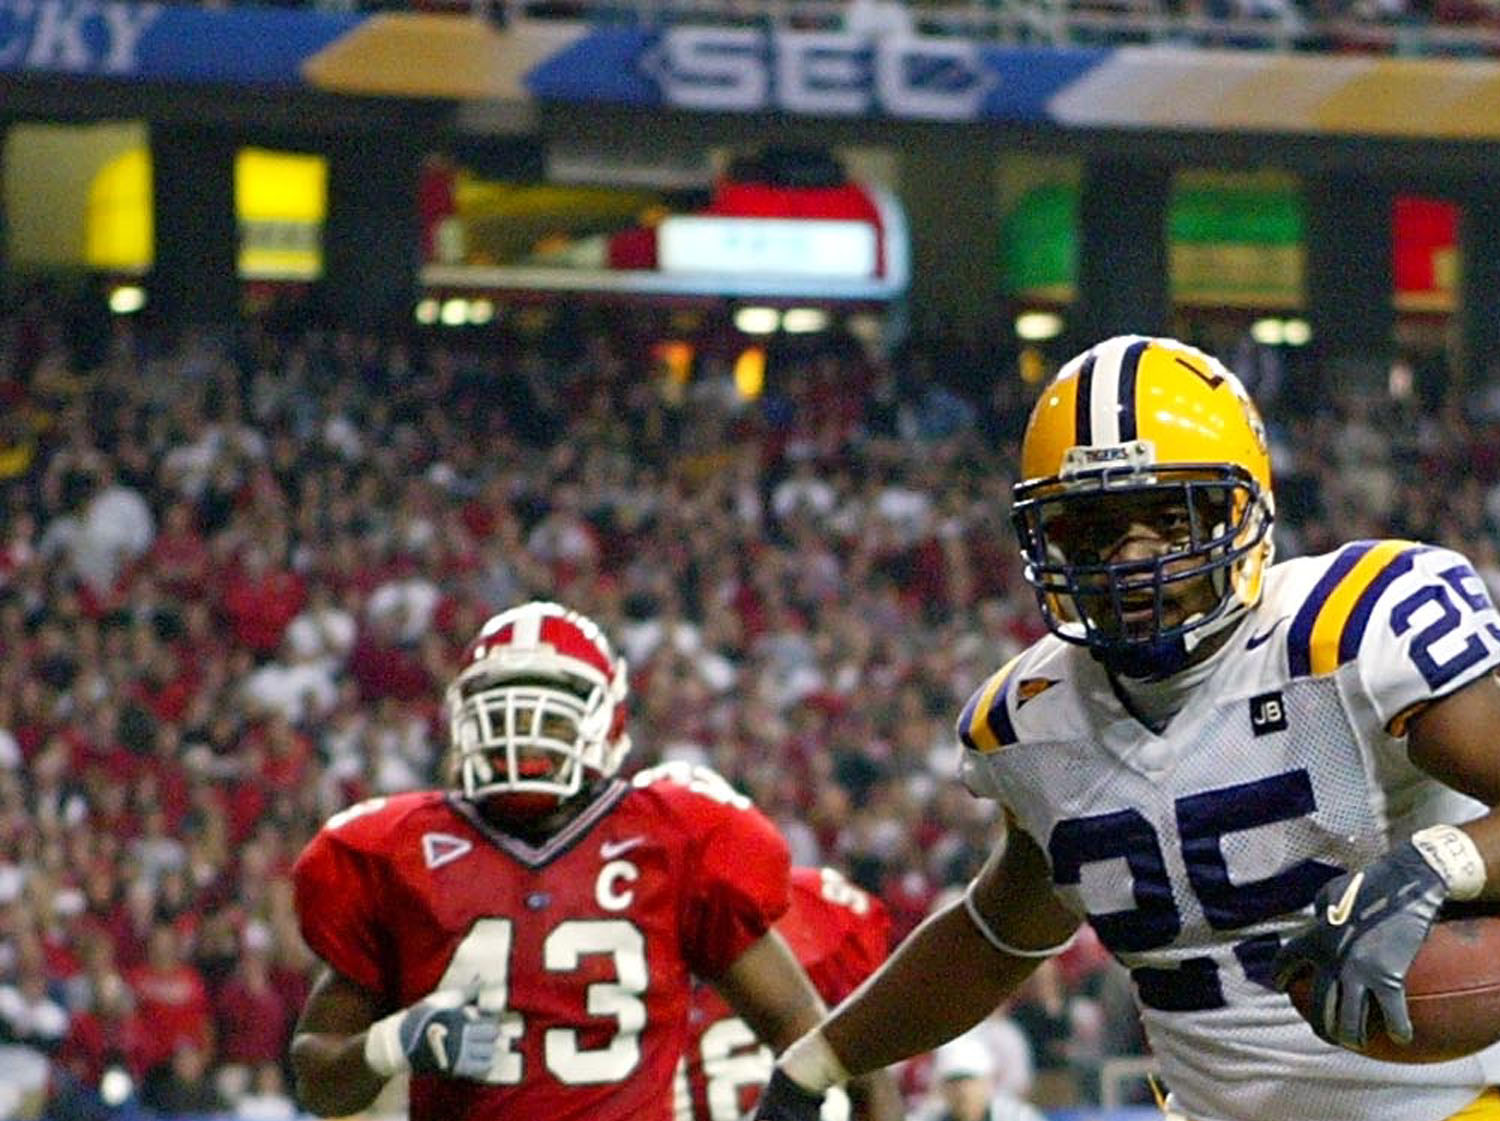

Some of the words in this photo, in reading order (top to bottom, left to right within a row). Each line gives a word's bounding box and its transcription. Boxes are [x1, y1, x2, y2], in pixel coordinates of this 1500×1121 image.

[645, 27, 996, 118] SEC
[1253, 700, 1282, 725] JB
[596, 860, 638, 911] C
[1048, 766, 1348, 1012] 25
[434, 917, 649, 1084] 43
